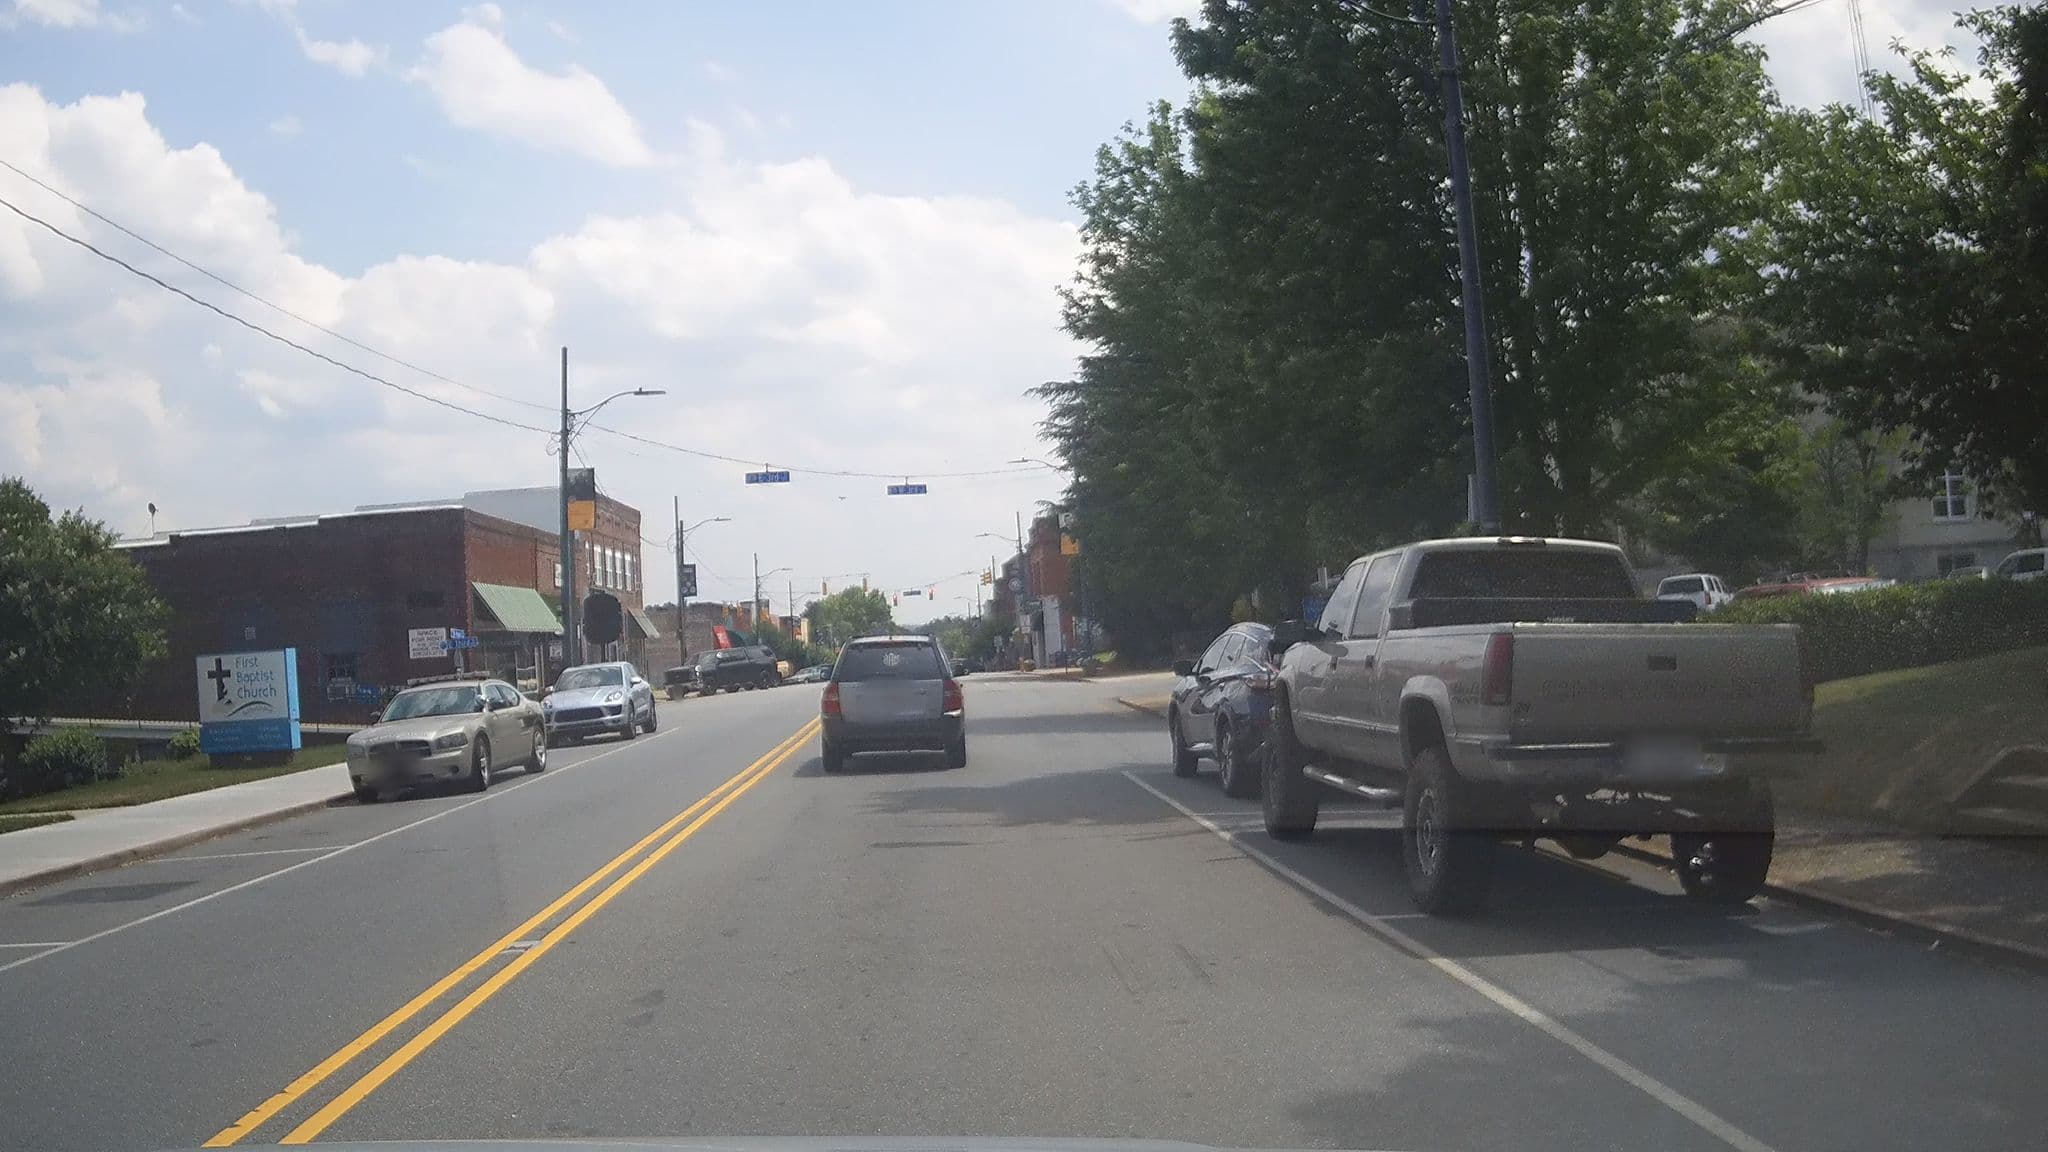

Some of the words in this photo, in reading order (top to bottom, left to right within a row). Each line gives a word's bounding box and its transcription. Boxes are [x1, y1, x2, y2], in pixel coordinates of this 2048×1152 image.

[235, 656, 259, 669] First
[236, 671, 275, 685] Baptist
[237, 684, 277, 699] Church
